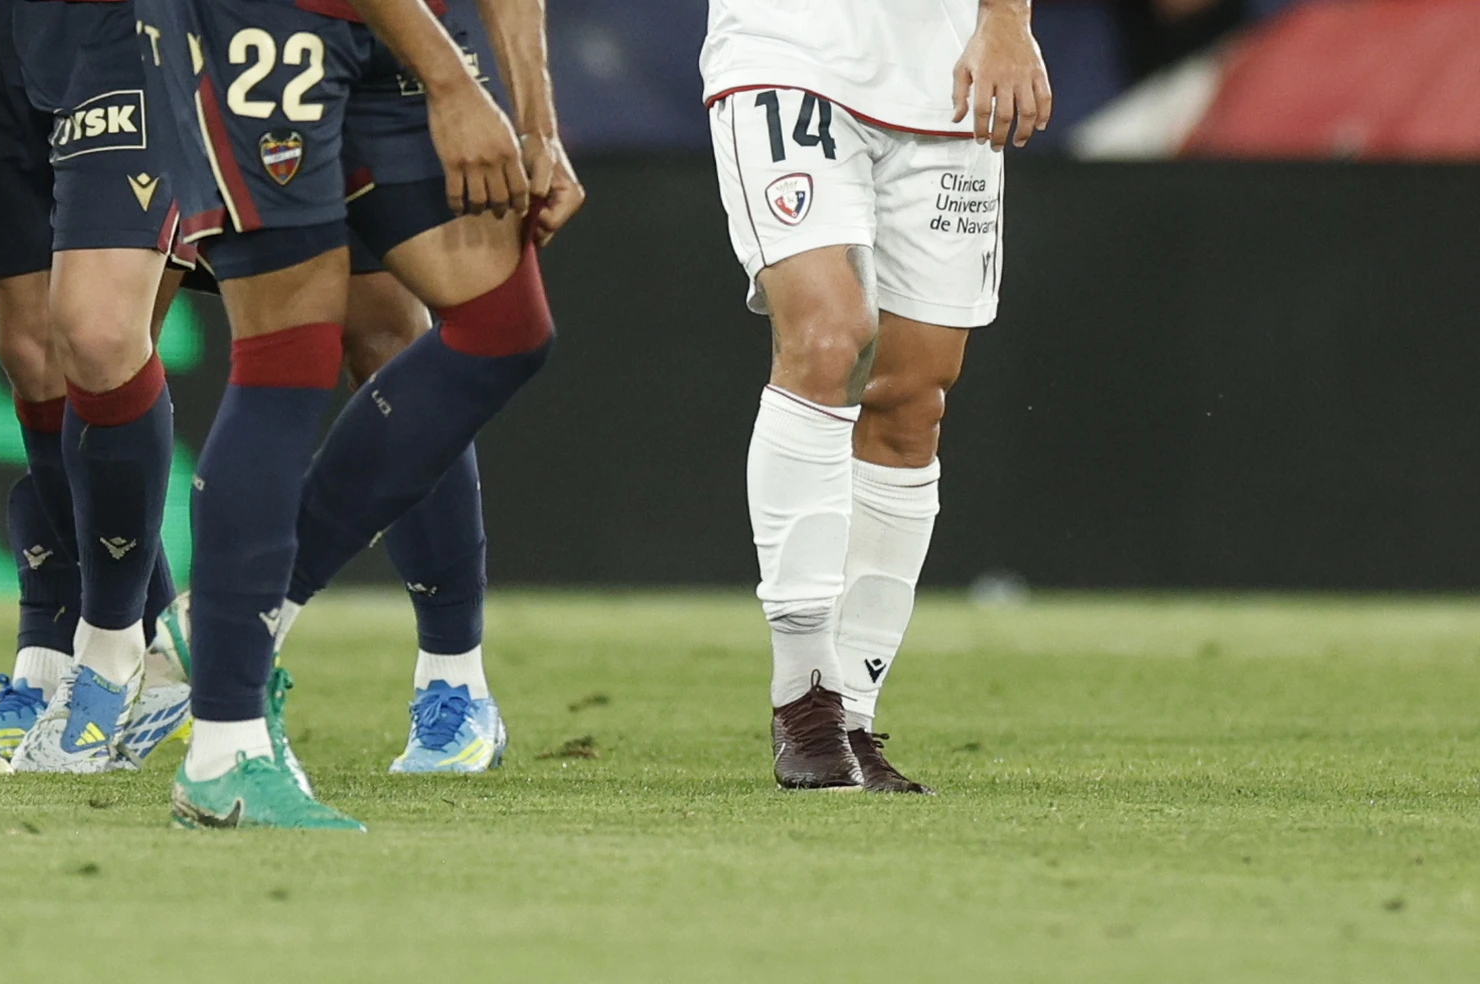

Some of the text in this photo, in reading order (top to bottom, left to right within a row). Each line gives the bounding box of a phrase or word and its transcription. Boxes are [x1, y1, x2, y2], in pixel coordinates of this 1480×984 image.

[227, 27, 324, 122] 22
[58, 104, 138, 146] JYSK
[754, 89, 837, 164] 14
[940, 172, 987, 193] Clínica
[929, 215, 952, 233] de
